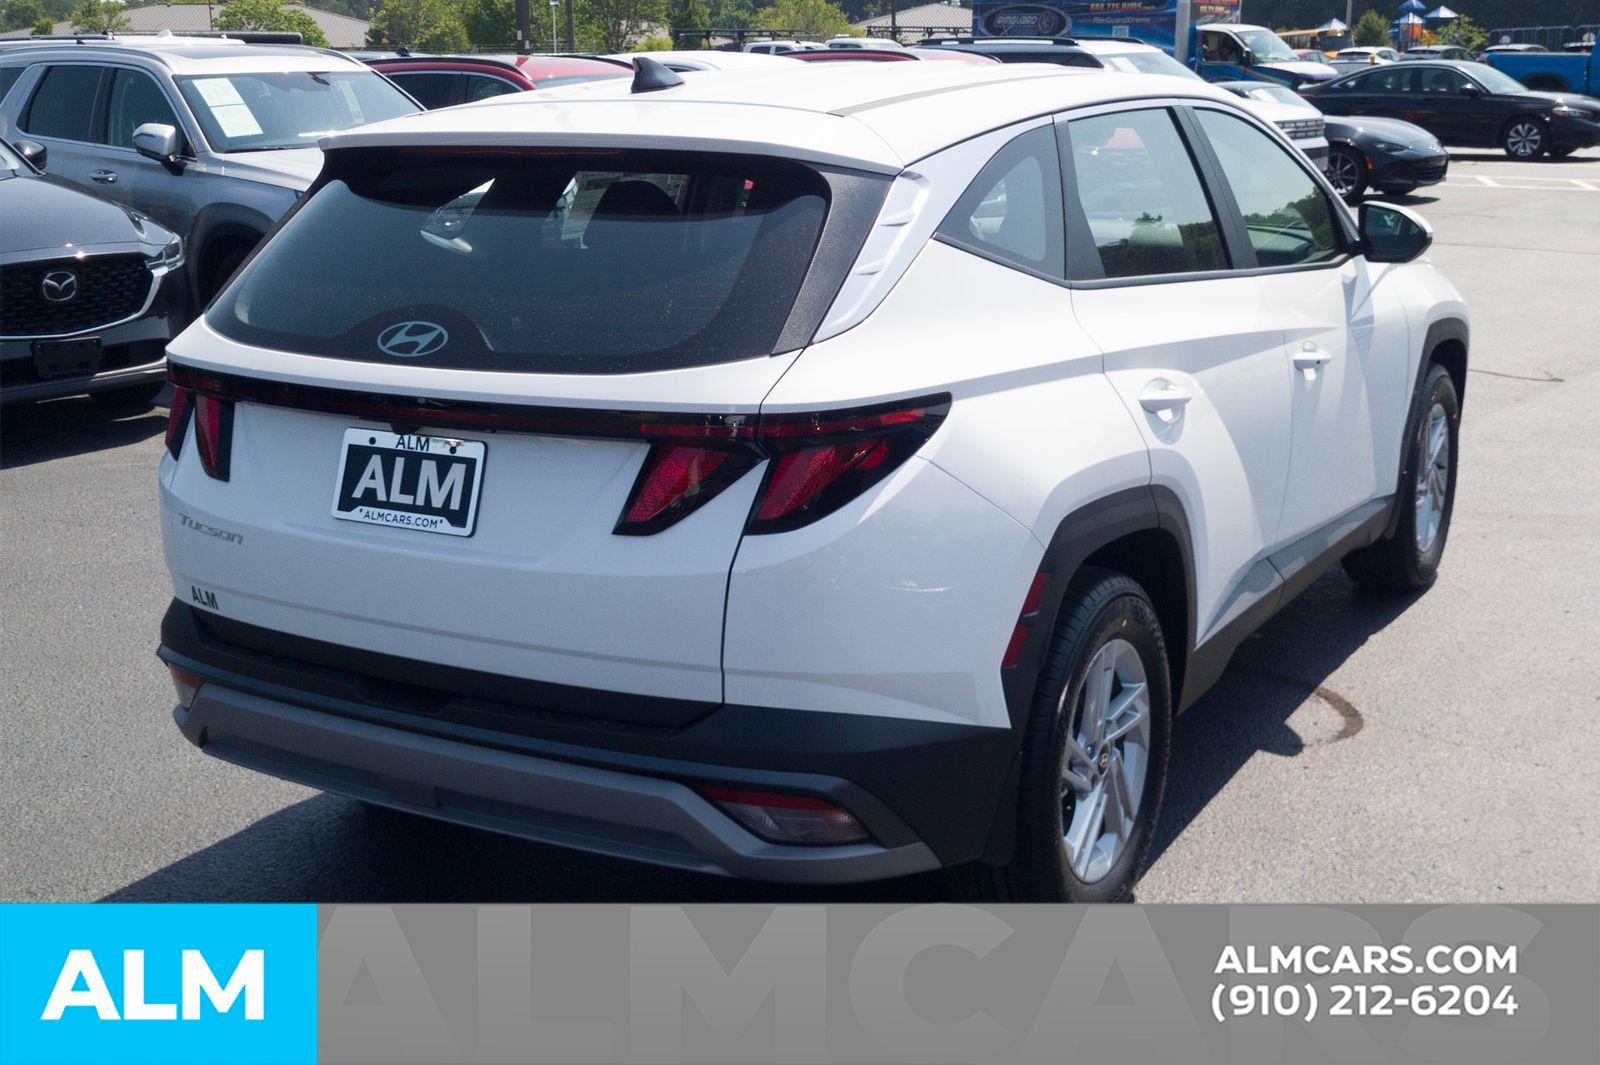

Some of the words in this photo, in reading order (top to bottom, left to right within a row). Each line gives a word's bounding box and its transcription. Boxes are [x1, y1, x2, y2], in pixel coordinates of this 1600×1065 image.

[395, 434, 430, 452] ALM
[352, 454, 467, 511] ALM
[362, 510, 438, 529] ALMCARS.COM
[191, 585, 219, 611] ALM
